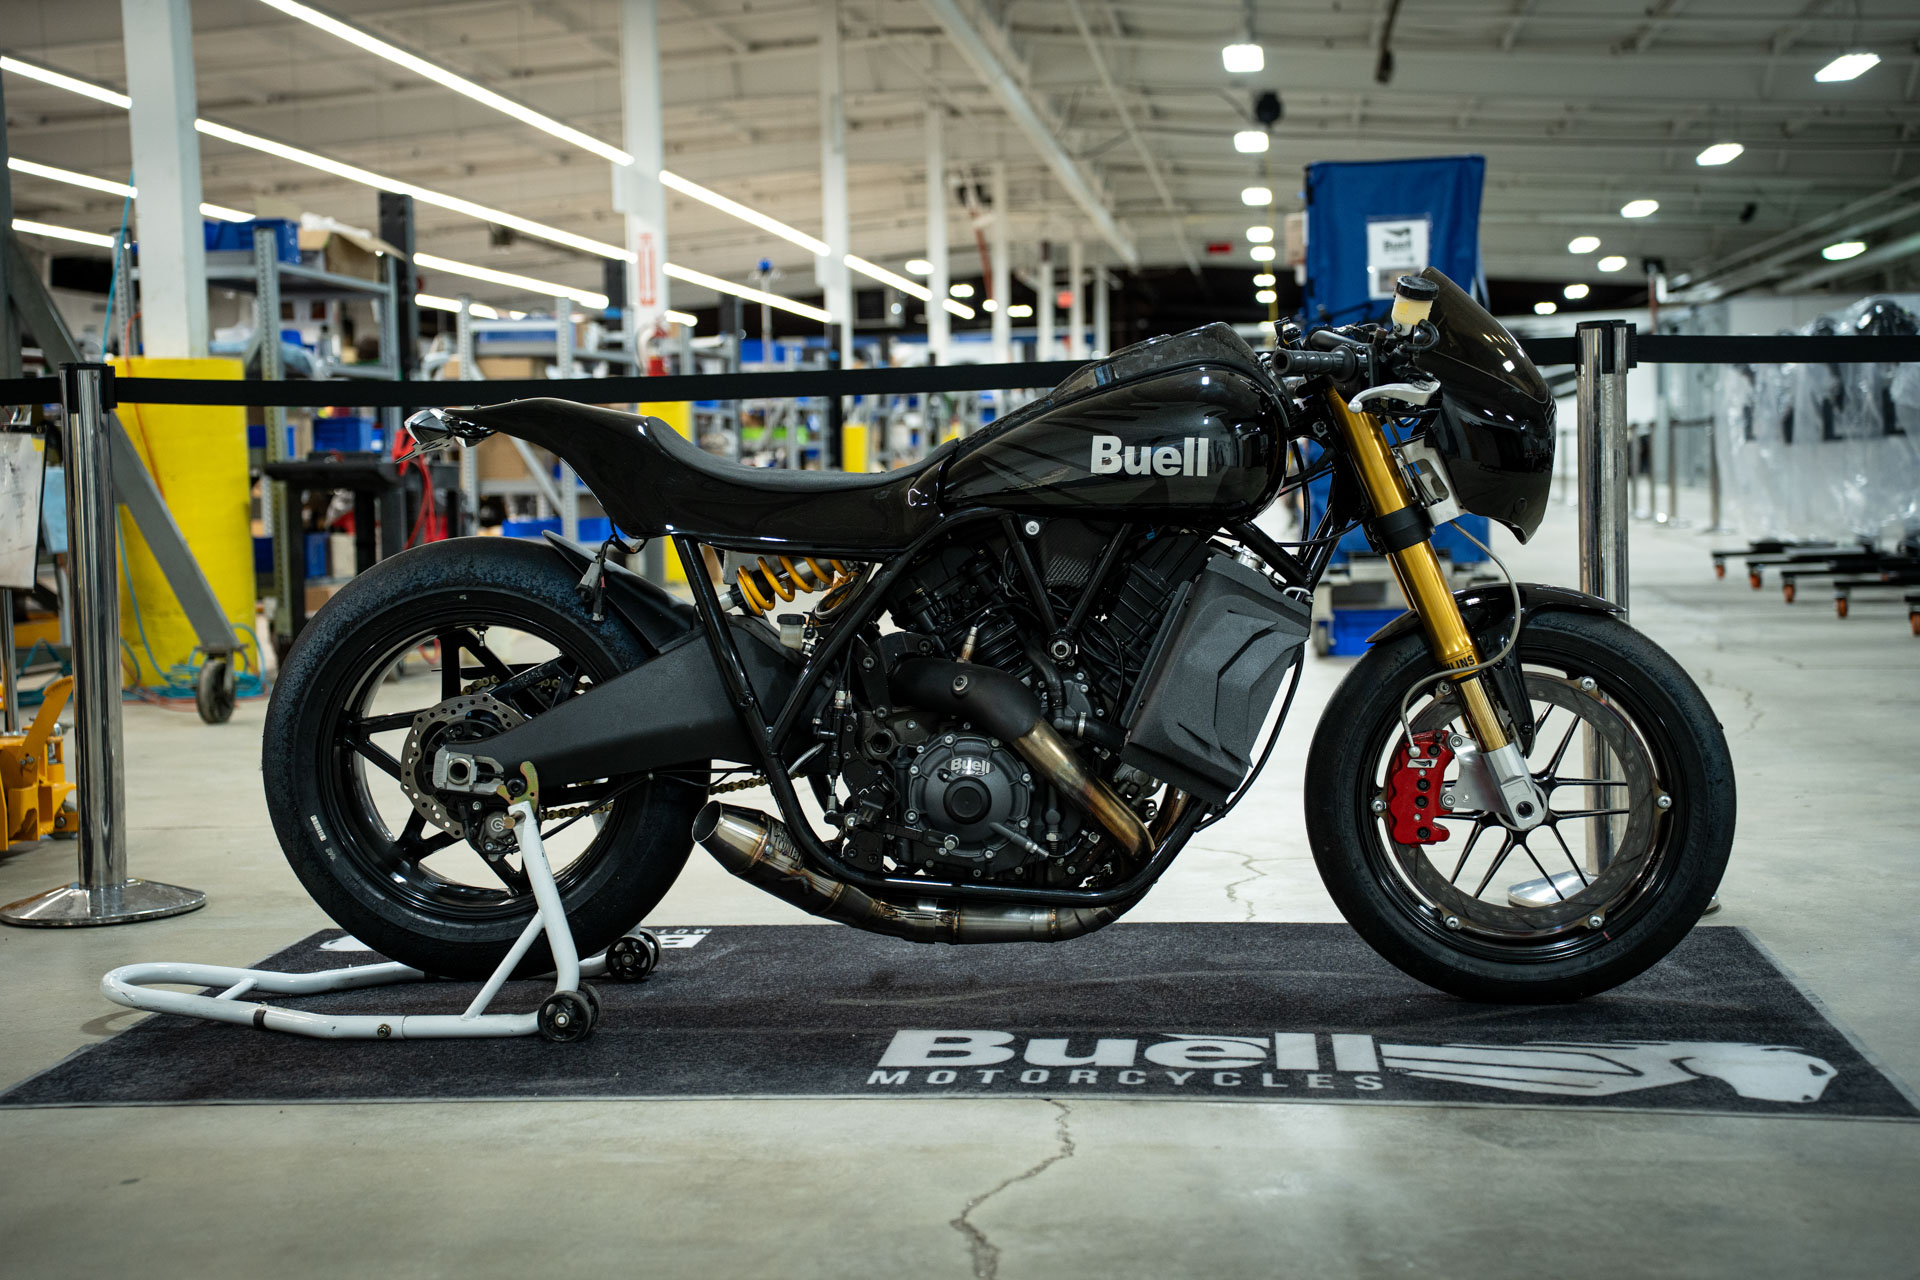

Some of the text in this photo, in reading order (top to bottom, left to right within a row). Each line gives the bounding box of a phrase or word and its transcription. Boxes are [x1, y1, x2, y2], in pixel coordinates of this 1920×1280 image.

[1090, 435, 1209, 477] Buell
[950, 757, 990, 773] Buell
[877, 1029, 1380, 1072] Buell
[866, 1069, 1384, 1091] MOTORCYCLES
